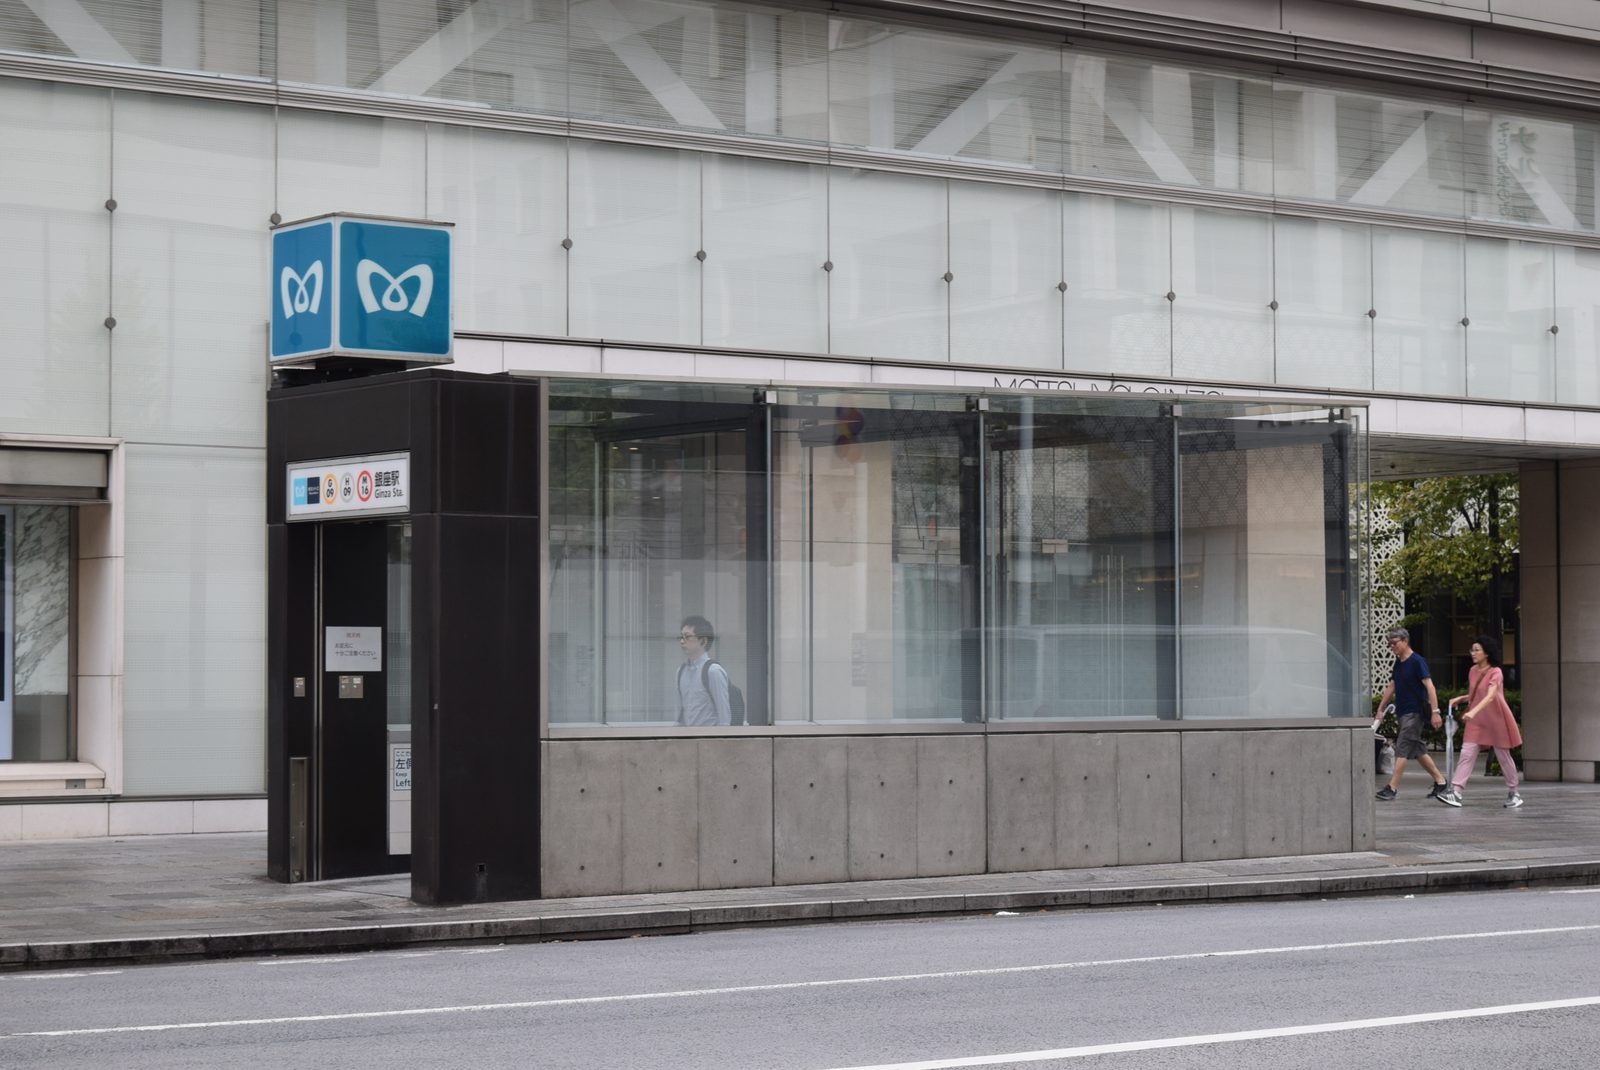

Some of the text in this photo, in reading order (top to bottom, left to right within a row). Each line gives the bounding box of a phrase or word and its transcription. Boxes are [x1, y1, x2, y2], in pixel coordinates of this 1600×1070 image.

[327, 478, 333, 488] G
[345, 477, 350, 486] H
[362, 476, 368, 484] M
[375, 470, 399, 487] 銀座駅
[326, 488, 335, 498] 09
[343, 487, 351, 497] 09
[361, 486, 369, 496] 16
[374, 488, 404, 499] Ginza Sta.
[395, 778, 411, 787] Left
